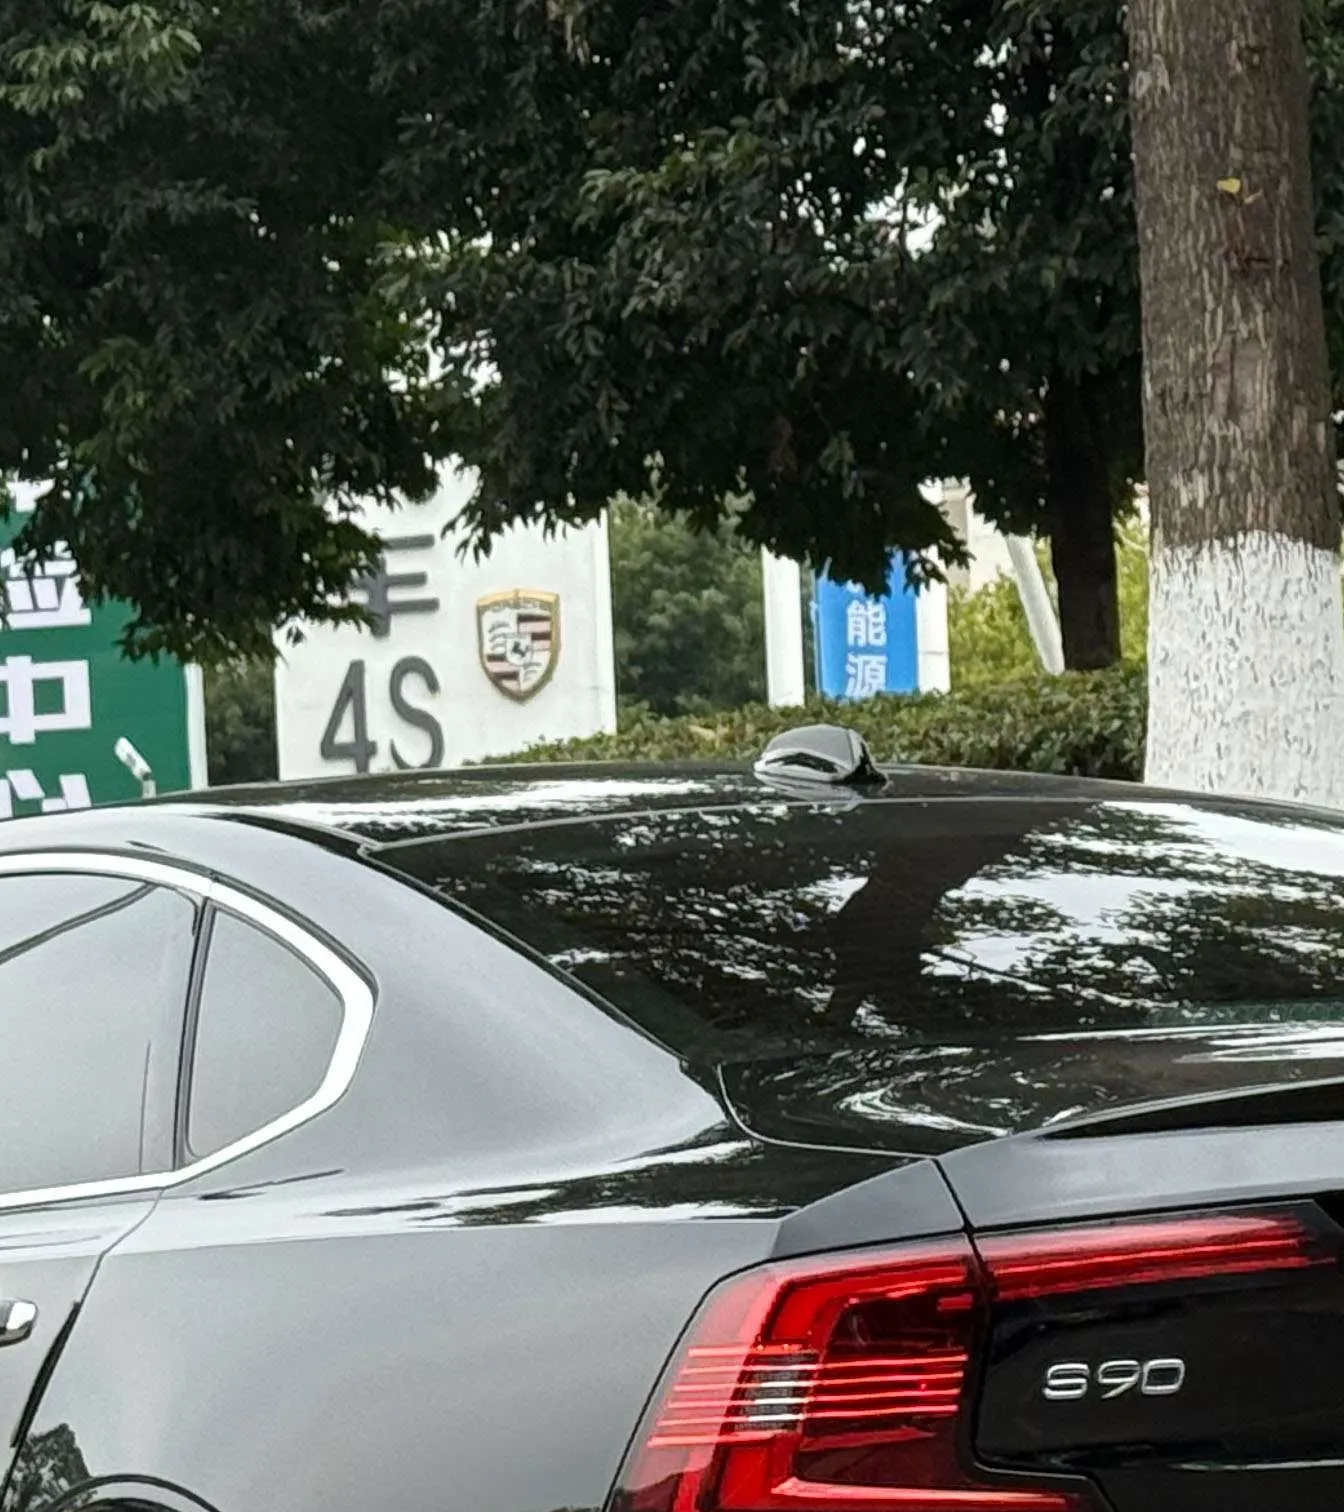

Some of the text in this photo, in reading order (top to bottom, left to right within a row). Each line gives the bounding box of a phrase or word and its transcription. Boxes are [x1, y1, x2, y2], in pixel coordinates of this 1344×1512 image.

[845, 579, 888, 700] 能源
[320, 655, 445, 773] 4S
[1042, 1358, 1186, 1400] S90
